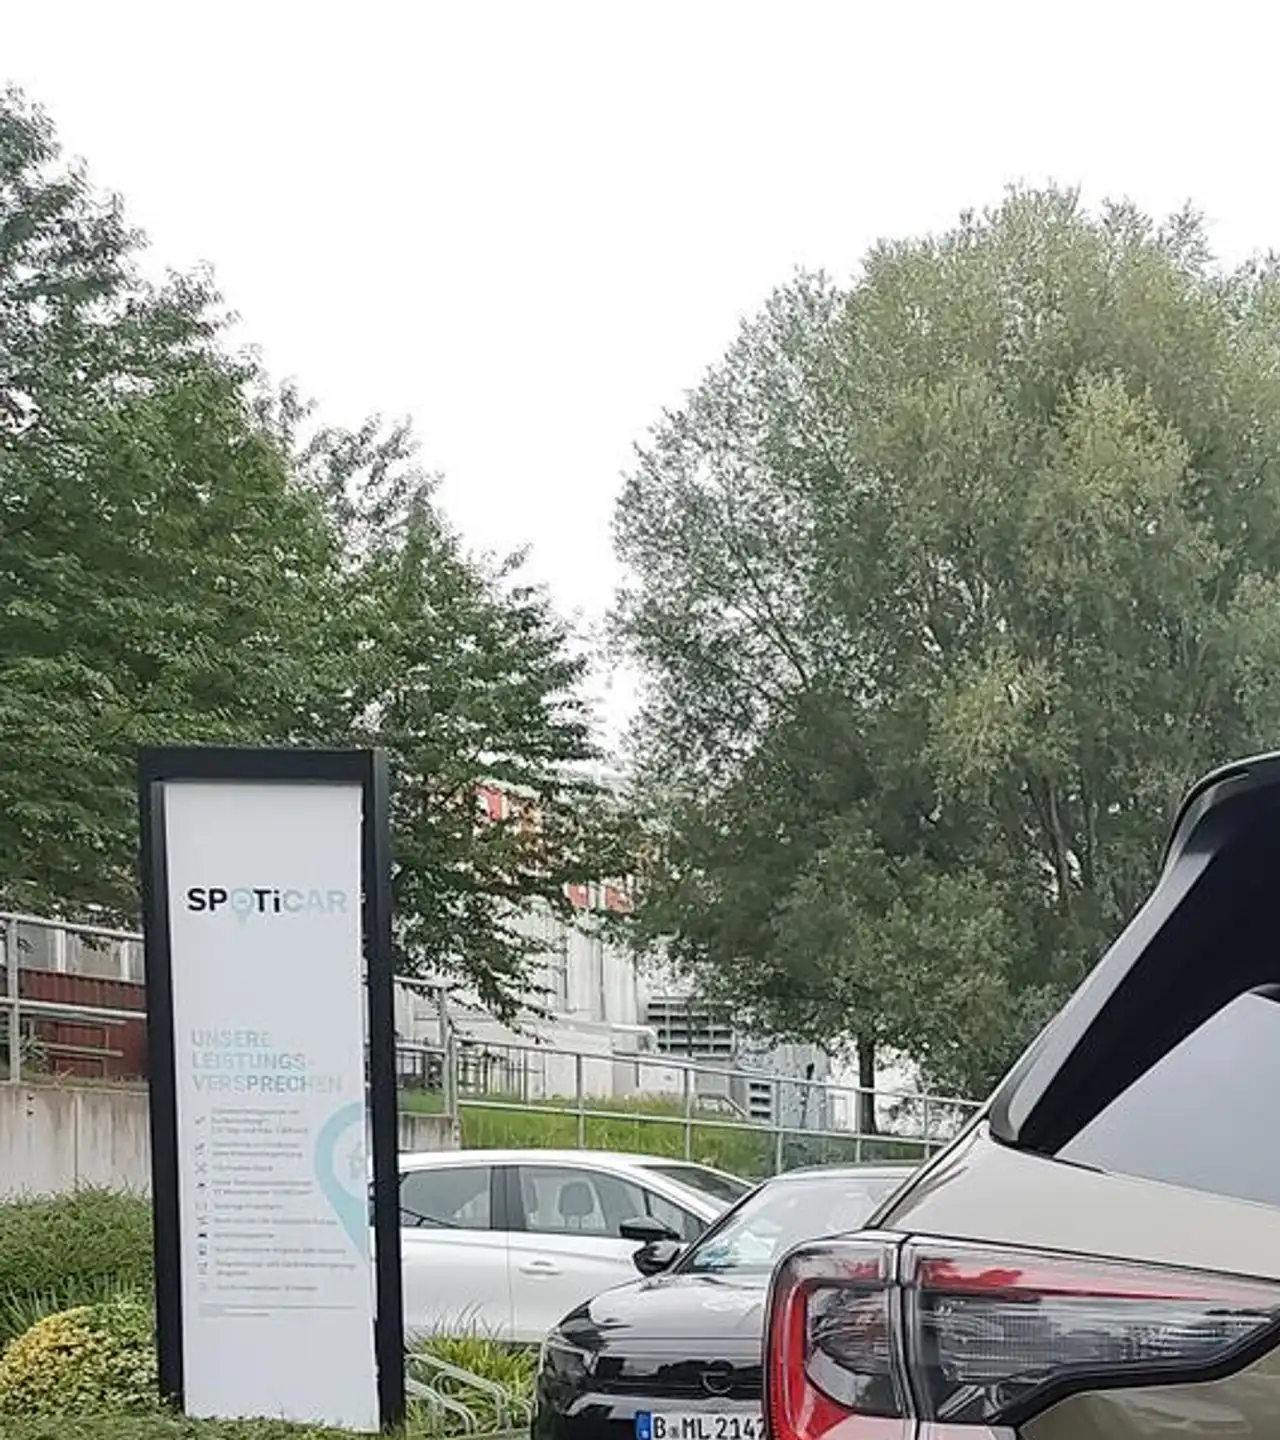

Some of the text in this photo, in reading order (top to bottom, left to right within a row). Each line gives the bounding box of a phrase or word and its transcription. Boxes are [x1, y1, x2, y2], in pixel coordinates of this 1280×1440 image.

[191, 1030, 271, 1048] UNSERE
[193, 1074, 343, 1095] VERSPRECHEN
[653, 1416, 666, 1439] B
